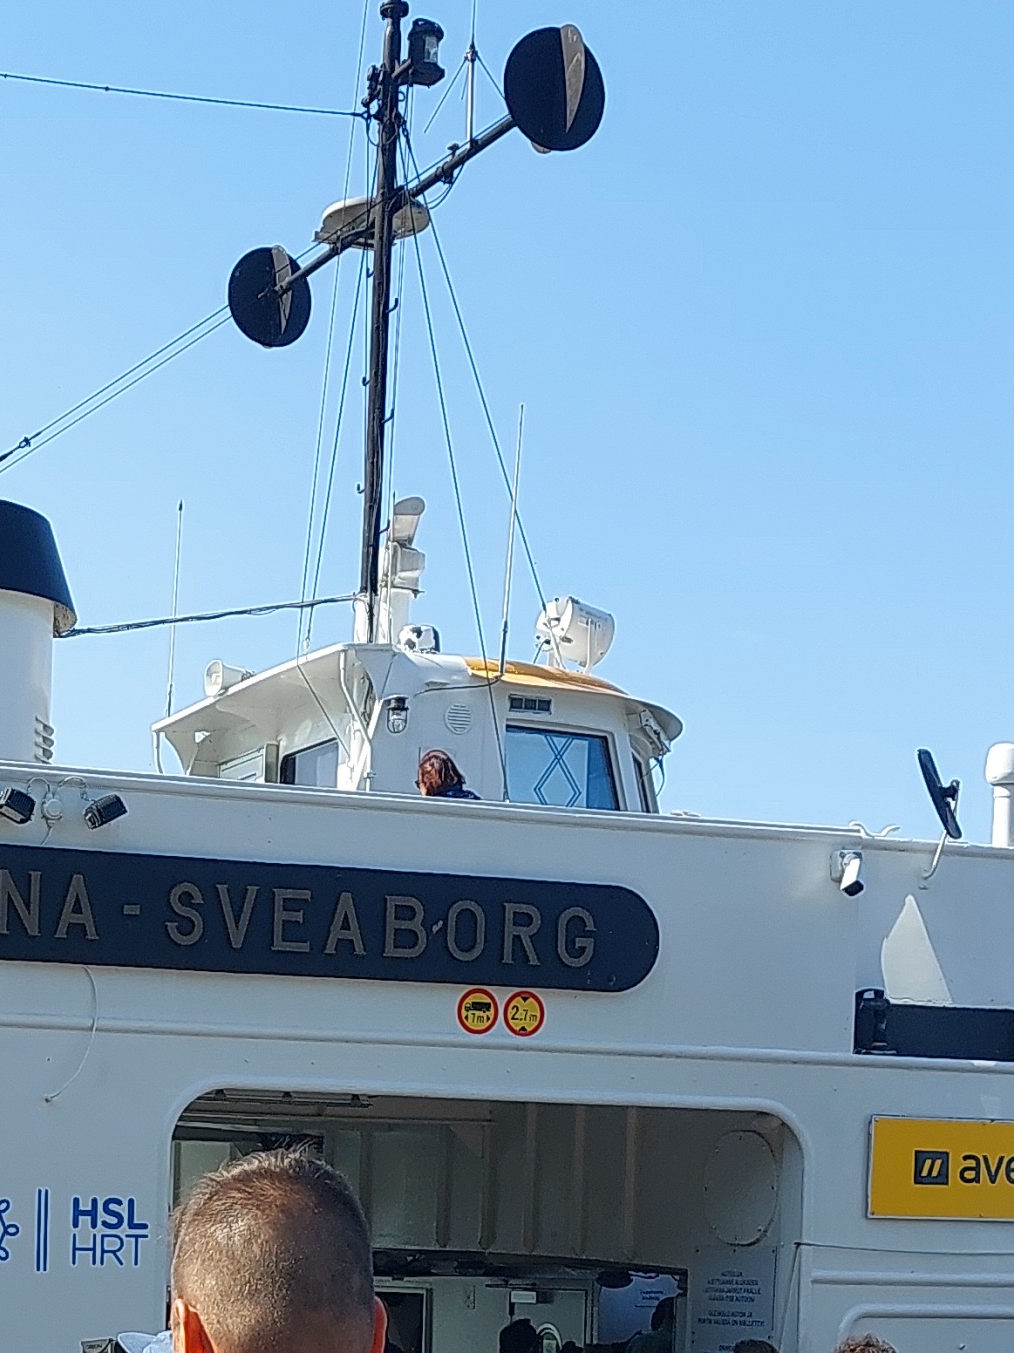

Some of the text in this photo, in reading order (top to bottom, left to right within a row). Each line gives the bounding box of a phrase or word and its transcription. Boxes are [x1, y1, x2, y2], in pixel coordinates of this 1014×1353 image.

[165, 882, 597, 968] SVEABORG
[471, 1013, 485, 1024] 7m
[72, 1196, 149, 1230] HSL
[72, 1232, 149, 1267] HRT
